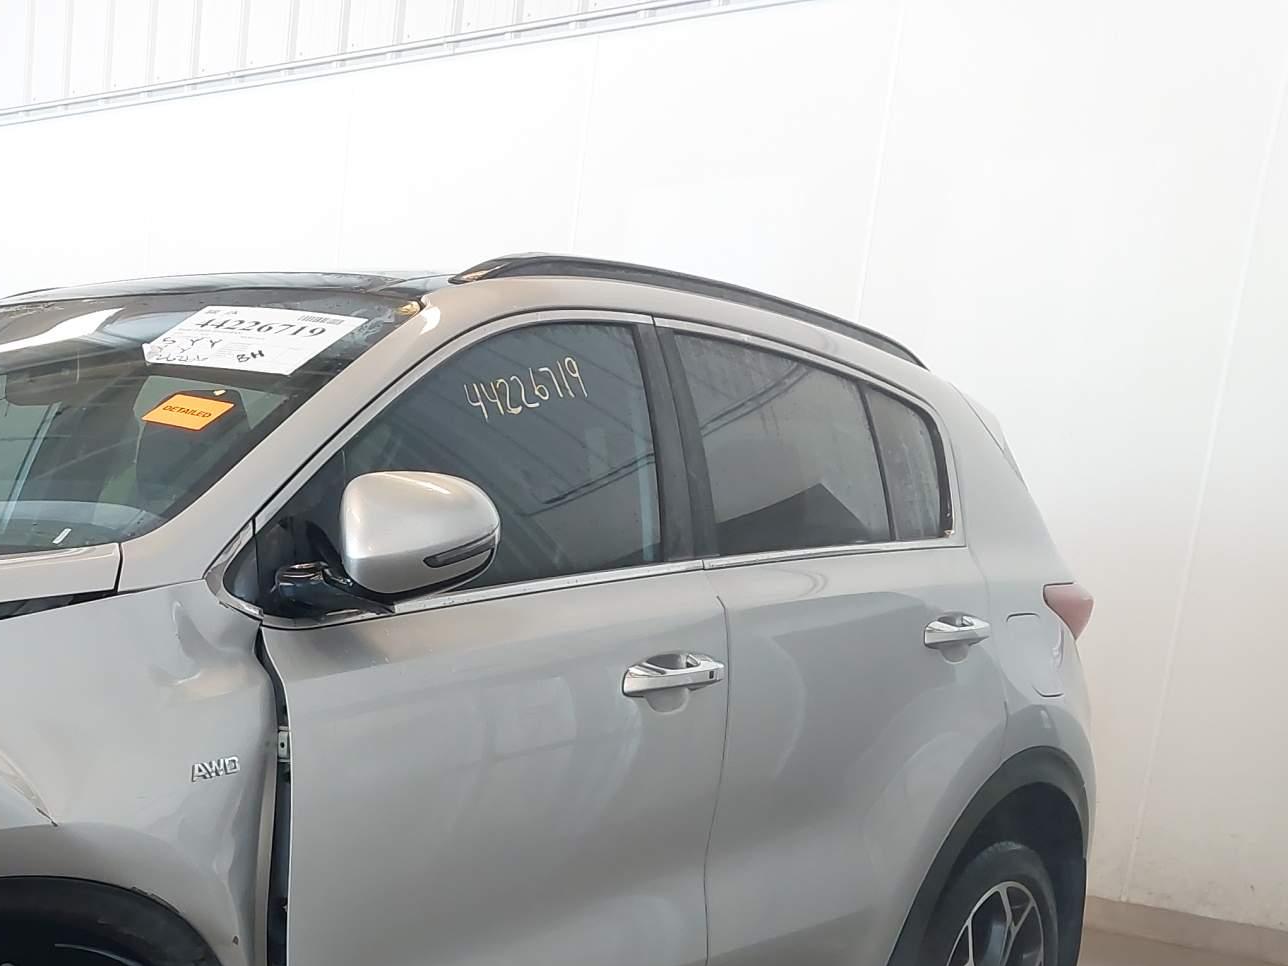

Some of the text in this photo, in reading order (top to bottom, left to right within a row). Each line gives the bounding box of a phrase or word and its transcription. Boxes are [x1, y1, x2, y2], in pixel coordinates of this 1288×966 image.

[196, 317, 327, 338] 44226719
[463, 356, 589, 422] 44226719
[161, 404, 213, 419] DETAILED
[191, 756, 241, 783] AWD
